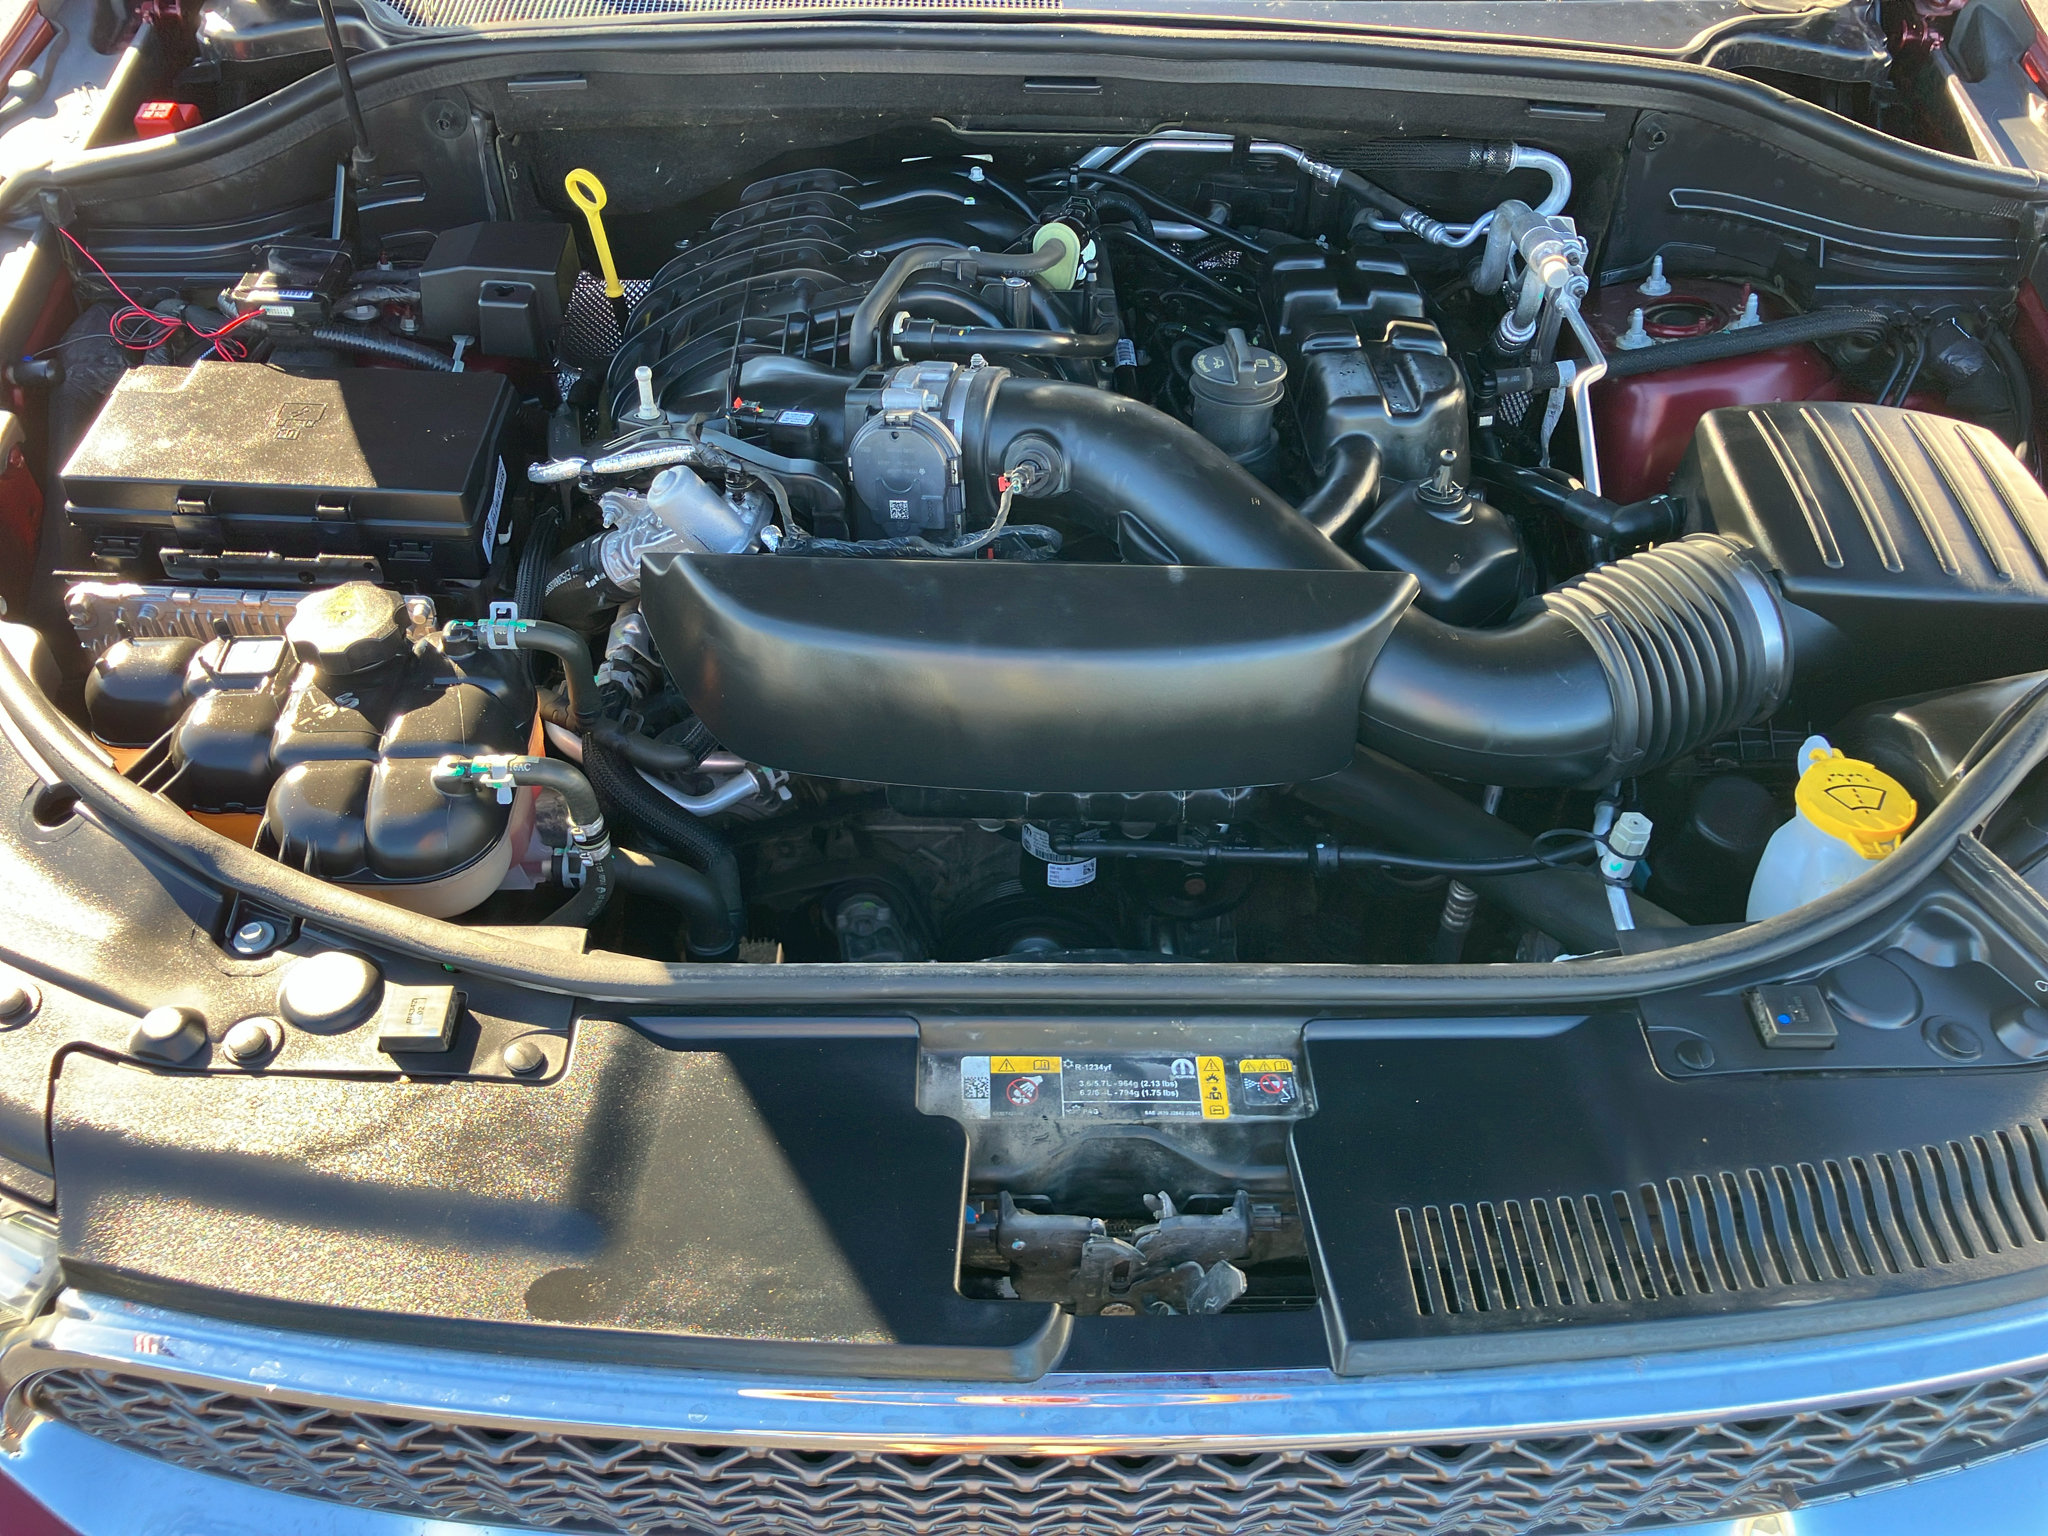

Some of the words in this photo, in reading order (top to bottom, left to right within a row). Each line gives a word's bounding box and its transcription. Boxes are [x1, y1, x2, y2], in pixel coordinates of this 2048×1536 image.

[1075, 1063, 1112, 1072] R-1234yf
[1140, 1080, 1161, 1089] (2.13
[1162, 1080, 1178, 1089] lbs)
[1119, 1089, 1140, 1098] 794g
[1141, 1089, 1162, 1098] (1.75
[1163, 1089, 1179, 1098] lbs)
